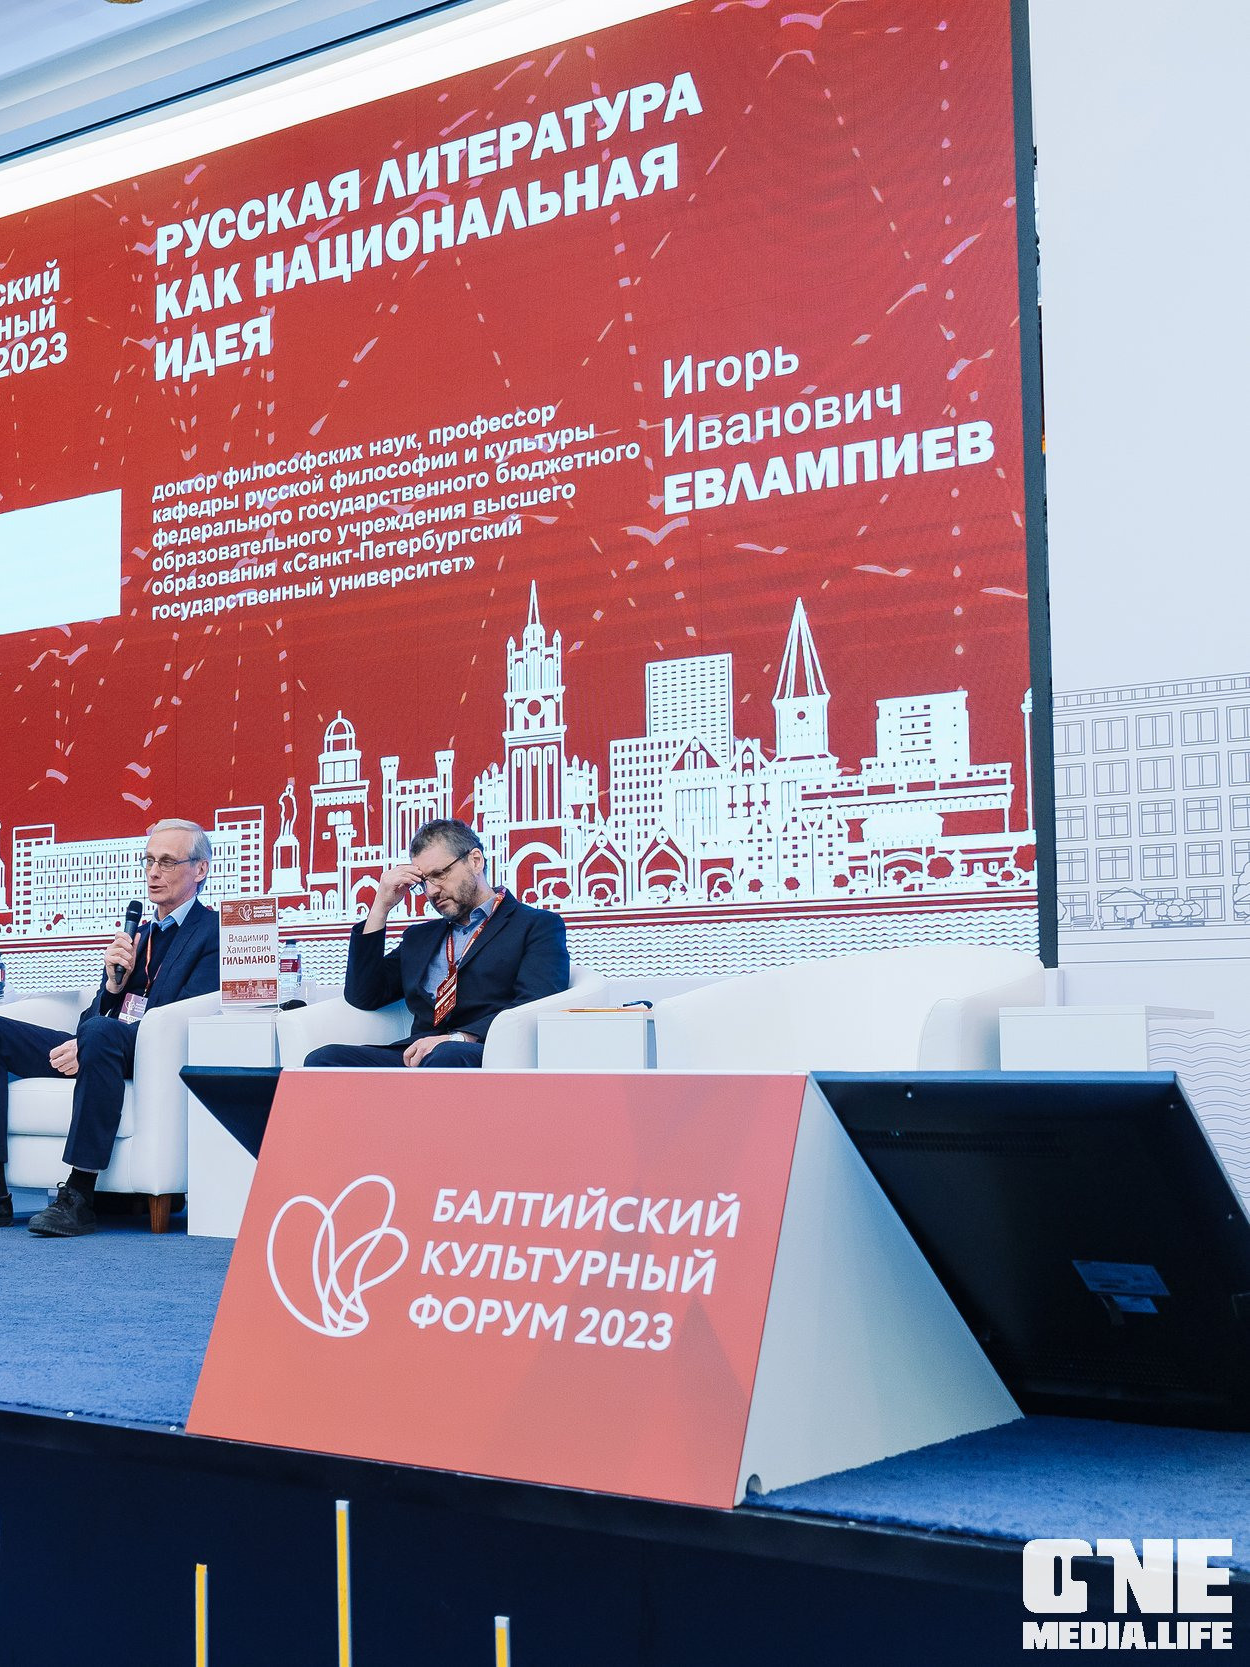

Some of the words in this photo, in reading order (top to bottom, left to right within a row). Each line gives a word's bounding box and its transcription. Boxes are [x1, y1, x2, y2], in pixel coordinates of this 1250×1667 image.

[155, 169, 360, 266] РУССКАЯ
[373, 72, 703, 205] ЛИТЕРАТУРА
[155, 263, 243, 323] КАК
[254, 142, 679, 298] НАЦИОНАЛЬНАЯ
[155, 314, 272, 383] ИДЕЯ
[663, 346, 800, 399] Игорь
[151, 474, 218, 503] доктор
[222, 445, 363, 491] философских
[369, 432, 423, 460] наук,
[428, 405, 556, 452] профессор
[664, 384, 902, 457] Иванович
[152, 494, 240, 530] кафедры
[244, 475, 324, 511] русской
[329, 450, 458, 493] философии
[464, 447, 478, 463] и
[483, 424, 595, 463] культуры
[152, 508, 293, 553] федерального
[297, 474, 489, 524] государственного
[495, 441, 641, 485] бюджетного
[664, 420, 995, 515] ЕВЛАМПИЕВ
[152, 530, 332, 572] образовательного
[337, 505, 467, 545] учреждения
[472, 484, 577, 518] высшего
[152, 562, 277, 597] образования
[282, 516, 523, 574] «Санкт-Петербургский
[152, 577, 324, 622] государственный
[329, 555, 476, 598] университет»
[222, 955, 276, 966] ГИЛЬМАНОВ
[226, 945, 271, 954] Хамитович
[228, 934, 270, 943] Владимир
[432, 1187, 741, 1238] БАЛТИЙСКИЙ
[420, 1241, 717, 1295] КУЛЬТУРНЫЙ
[408, 1293, 568, 1341] ФОРУМ
[574, 1307, 673, 1351] 2023
